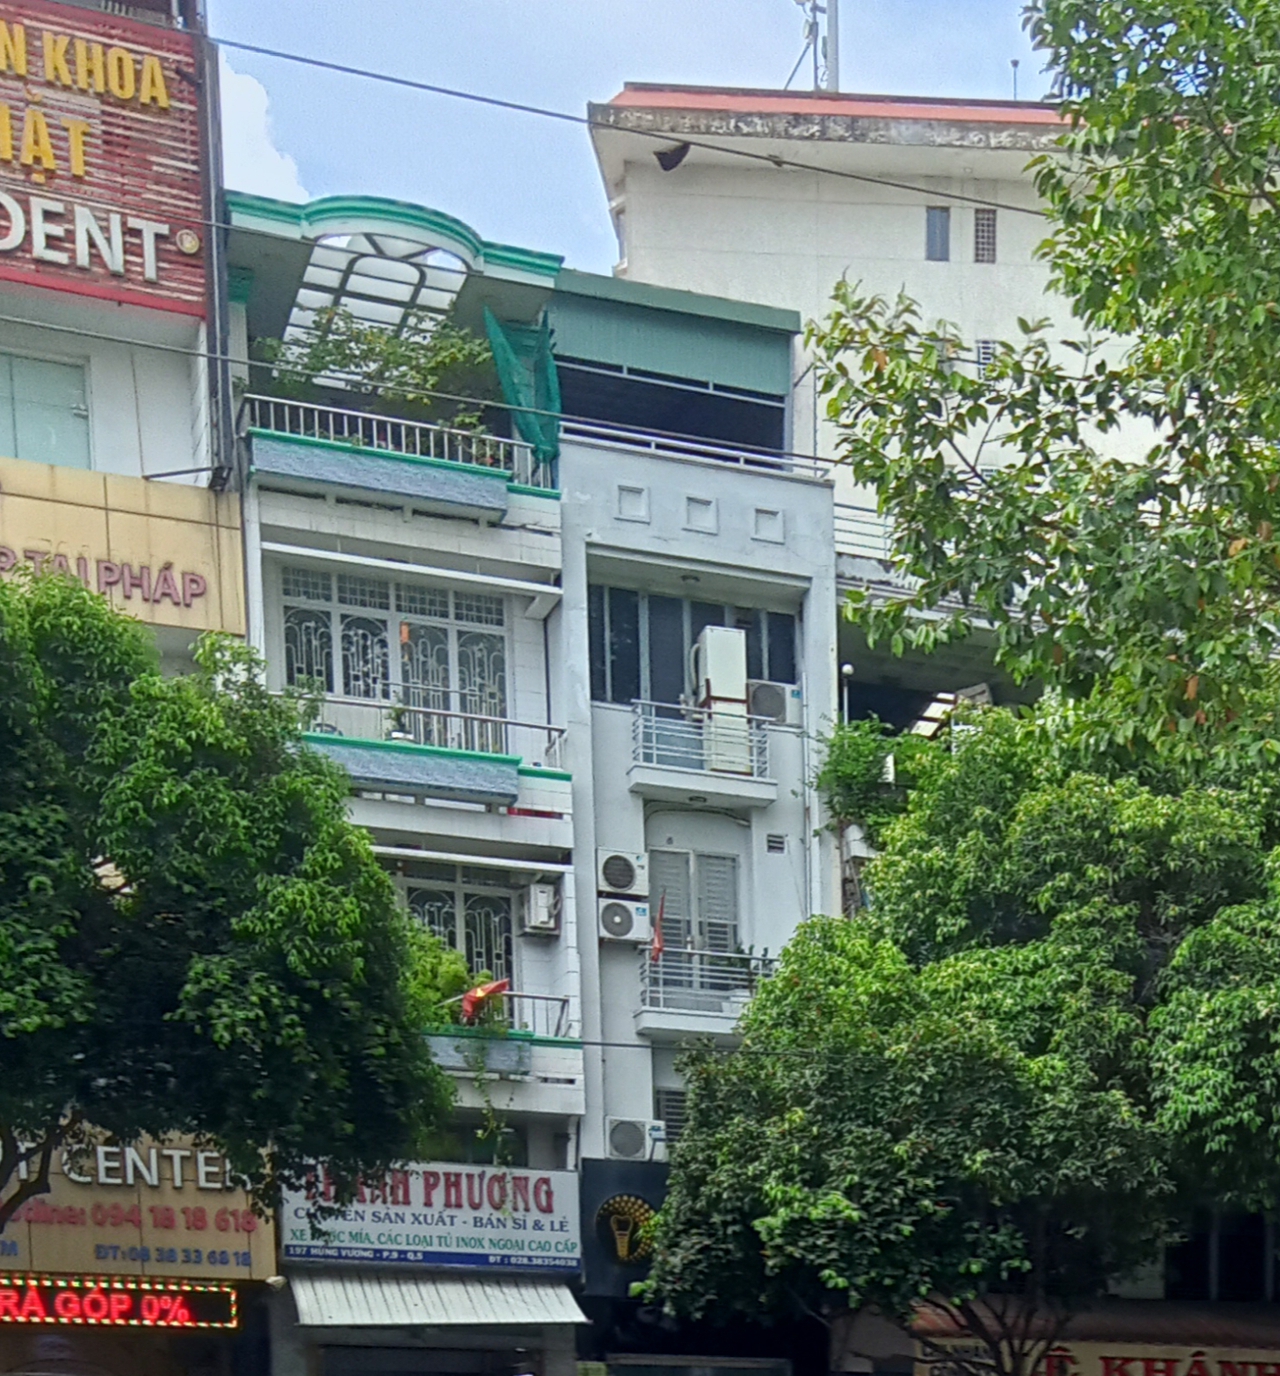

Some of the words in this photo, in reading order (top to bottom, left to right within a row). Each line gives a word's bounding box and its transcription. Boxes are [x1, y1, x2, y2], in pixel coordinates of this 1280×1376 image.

[42, 31, 169, 109] KHOA
[97, 560, 207, 607] PHÁP
[423, 1169, 554, 1213] PHƯƠNG
[411, 1209, 458, 1227] XUẤT
[473, 1213, 507, 1230] BÁN
[532, 1219, 545, 1232] &
[377, 1229, 404, 1246] CÁC
[456, 1236, 485, 1249] INOX
[141, 1295, 190, 1322] 0%
